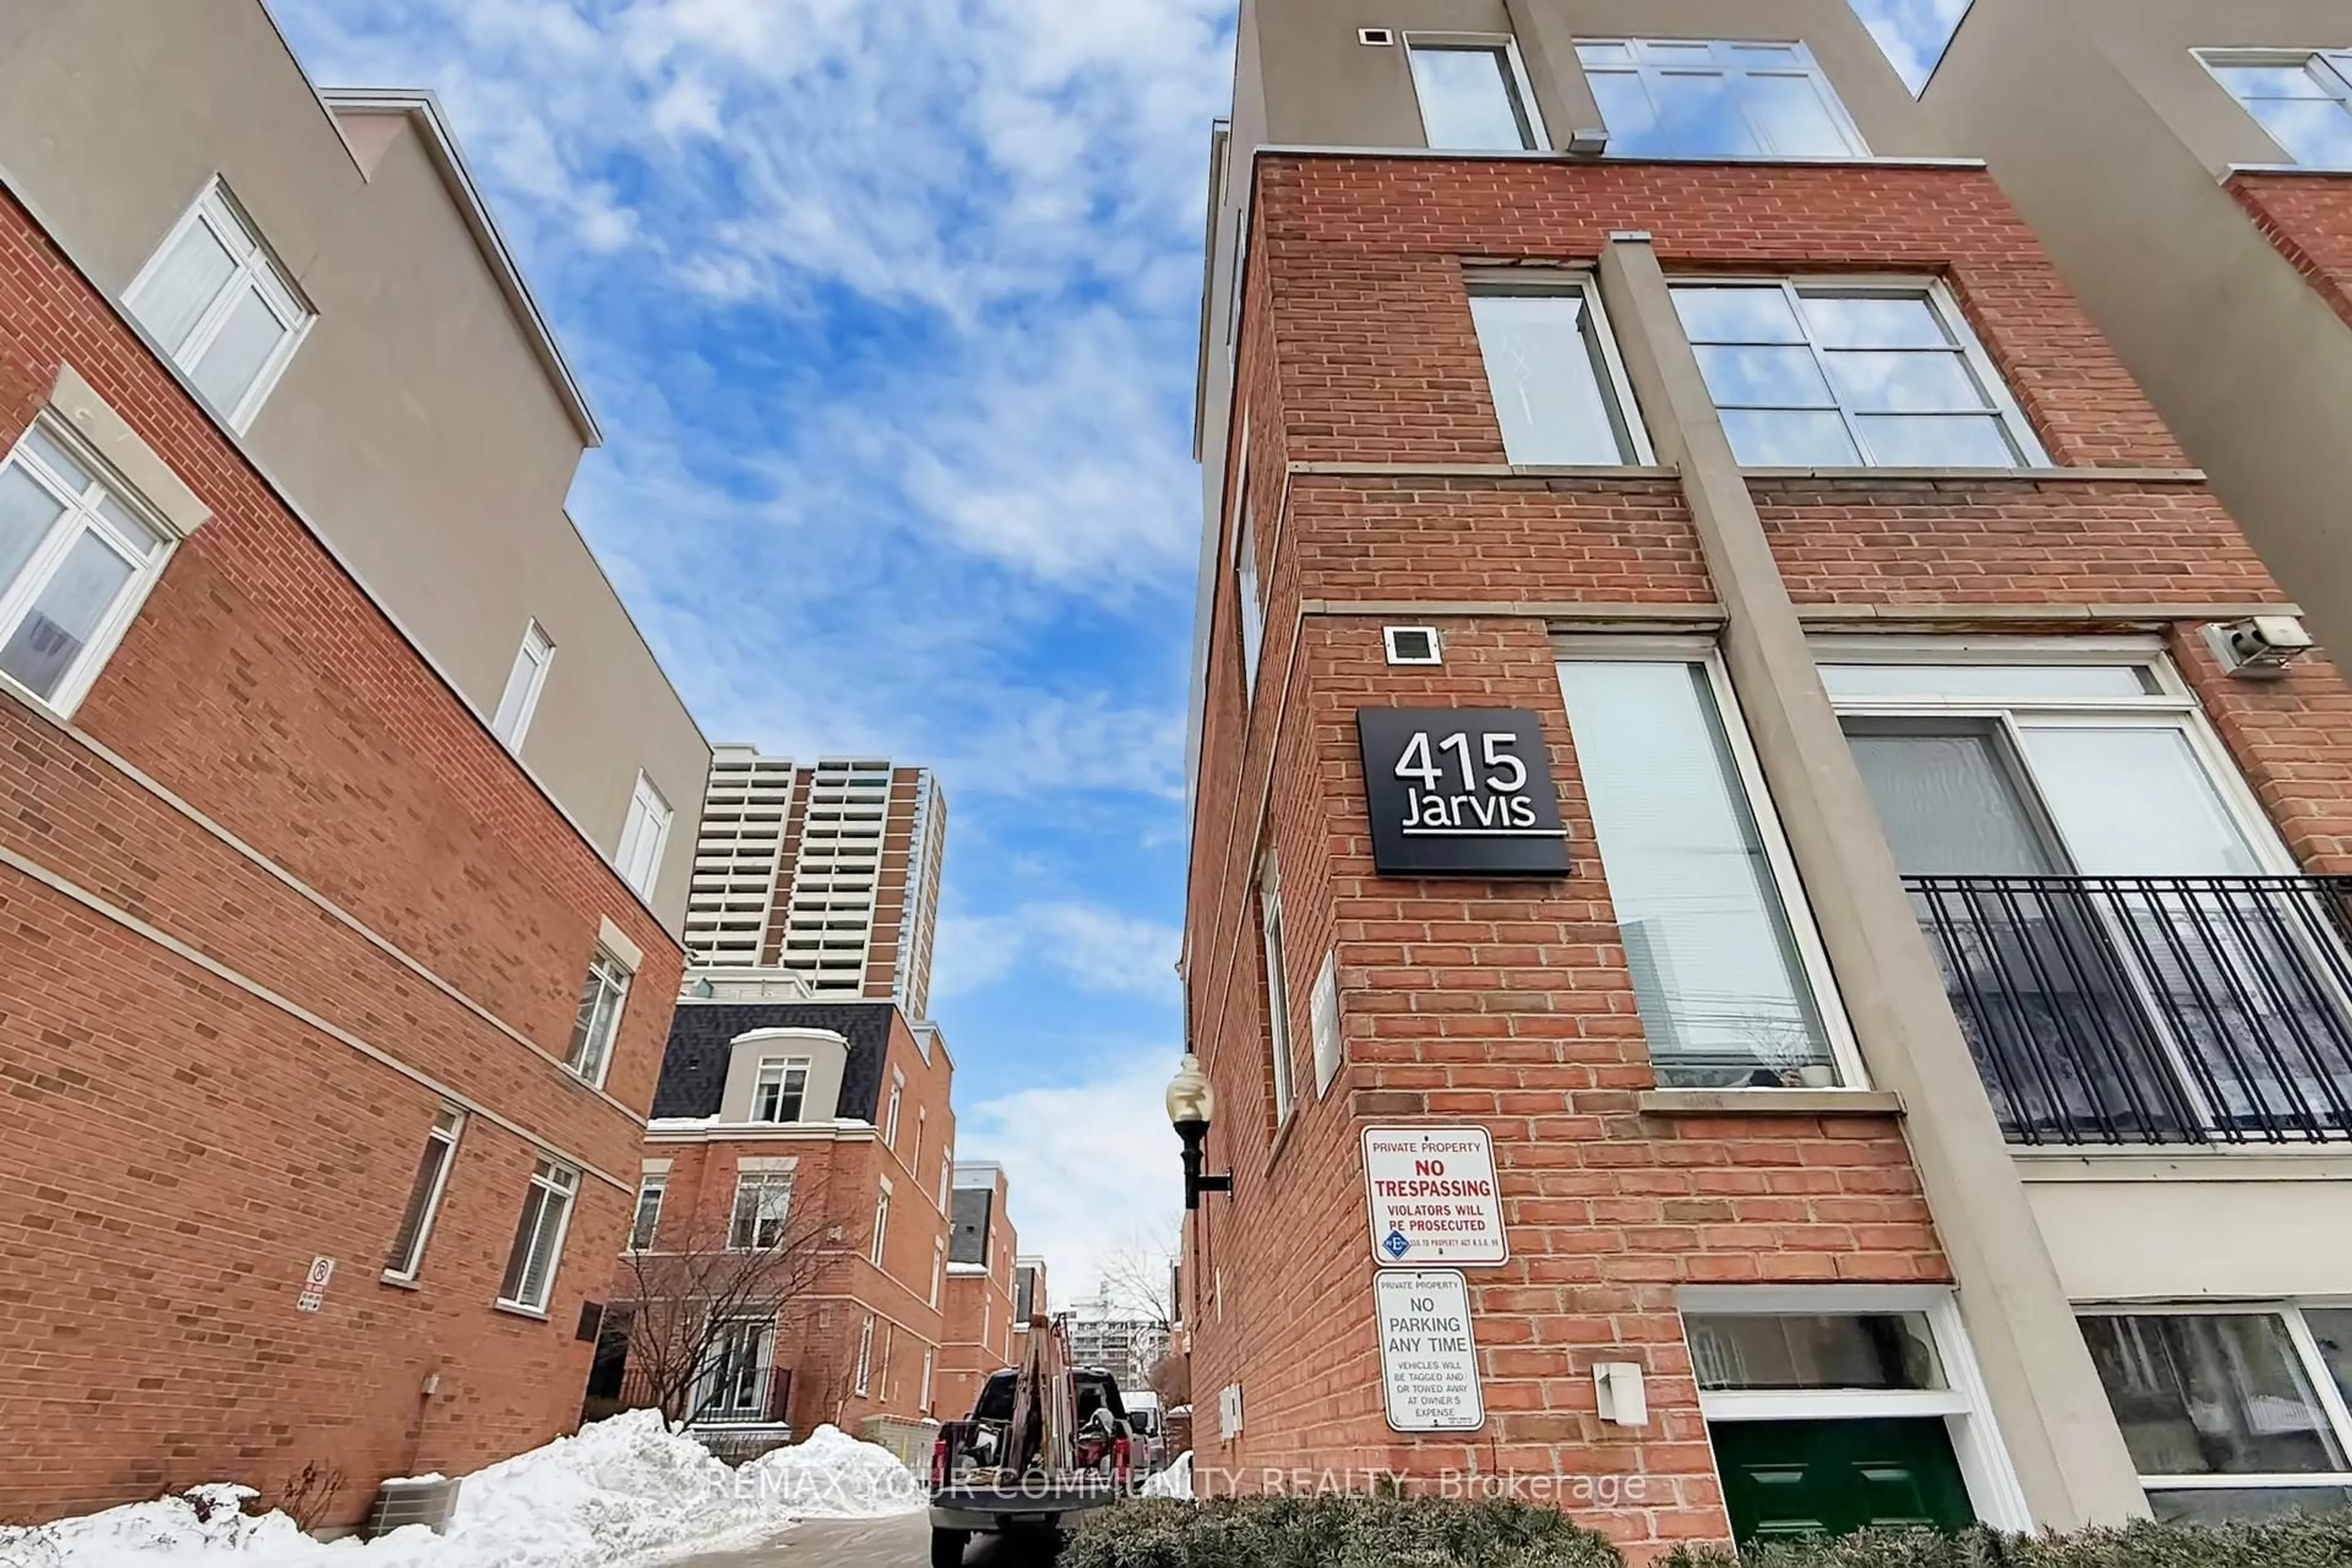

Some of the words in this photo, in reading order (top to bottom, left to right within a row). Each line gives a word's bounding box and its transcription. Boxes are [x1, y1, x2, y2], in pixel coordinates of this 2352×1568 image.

[1394, 732, 1528, 792] 415
[1402, 788, 1536, 827] Jarvis
[1373, 1142, 1417, 1153] PRIVATE
[1422, 1143, 1481, 1153] PROPERTY
[1415, 1160, 1444, 1176] NO
[1375, 1180, 1490, 1197] TRESPASSING
[1387, 1205, 1451, 1216] VIOLATORS
[1455, 1205, 1484, 1216] WILL
[1410, 1220, 1486, 1231] PROSECUTED
[1411, 1298, 1434, 1311] NO
[1390, 1318, 1460, 1332] PARKING
[1389, 1338, 1421, 1352] ANY
[1428, 1338, 1468, 1352] TIME
[1415, 1408, 1455, 1417] EXPENSE
